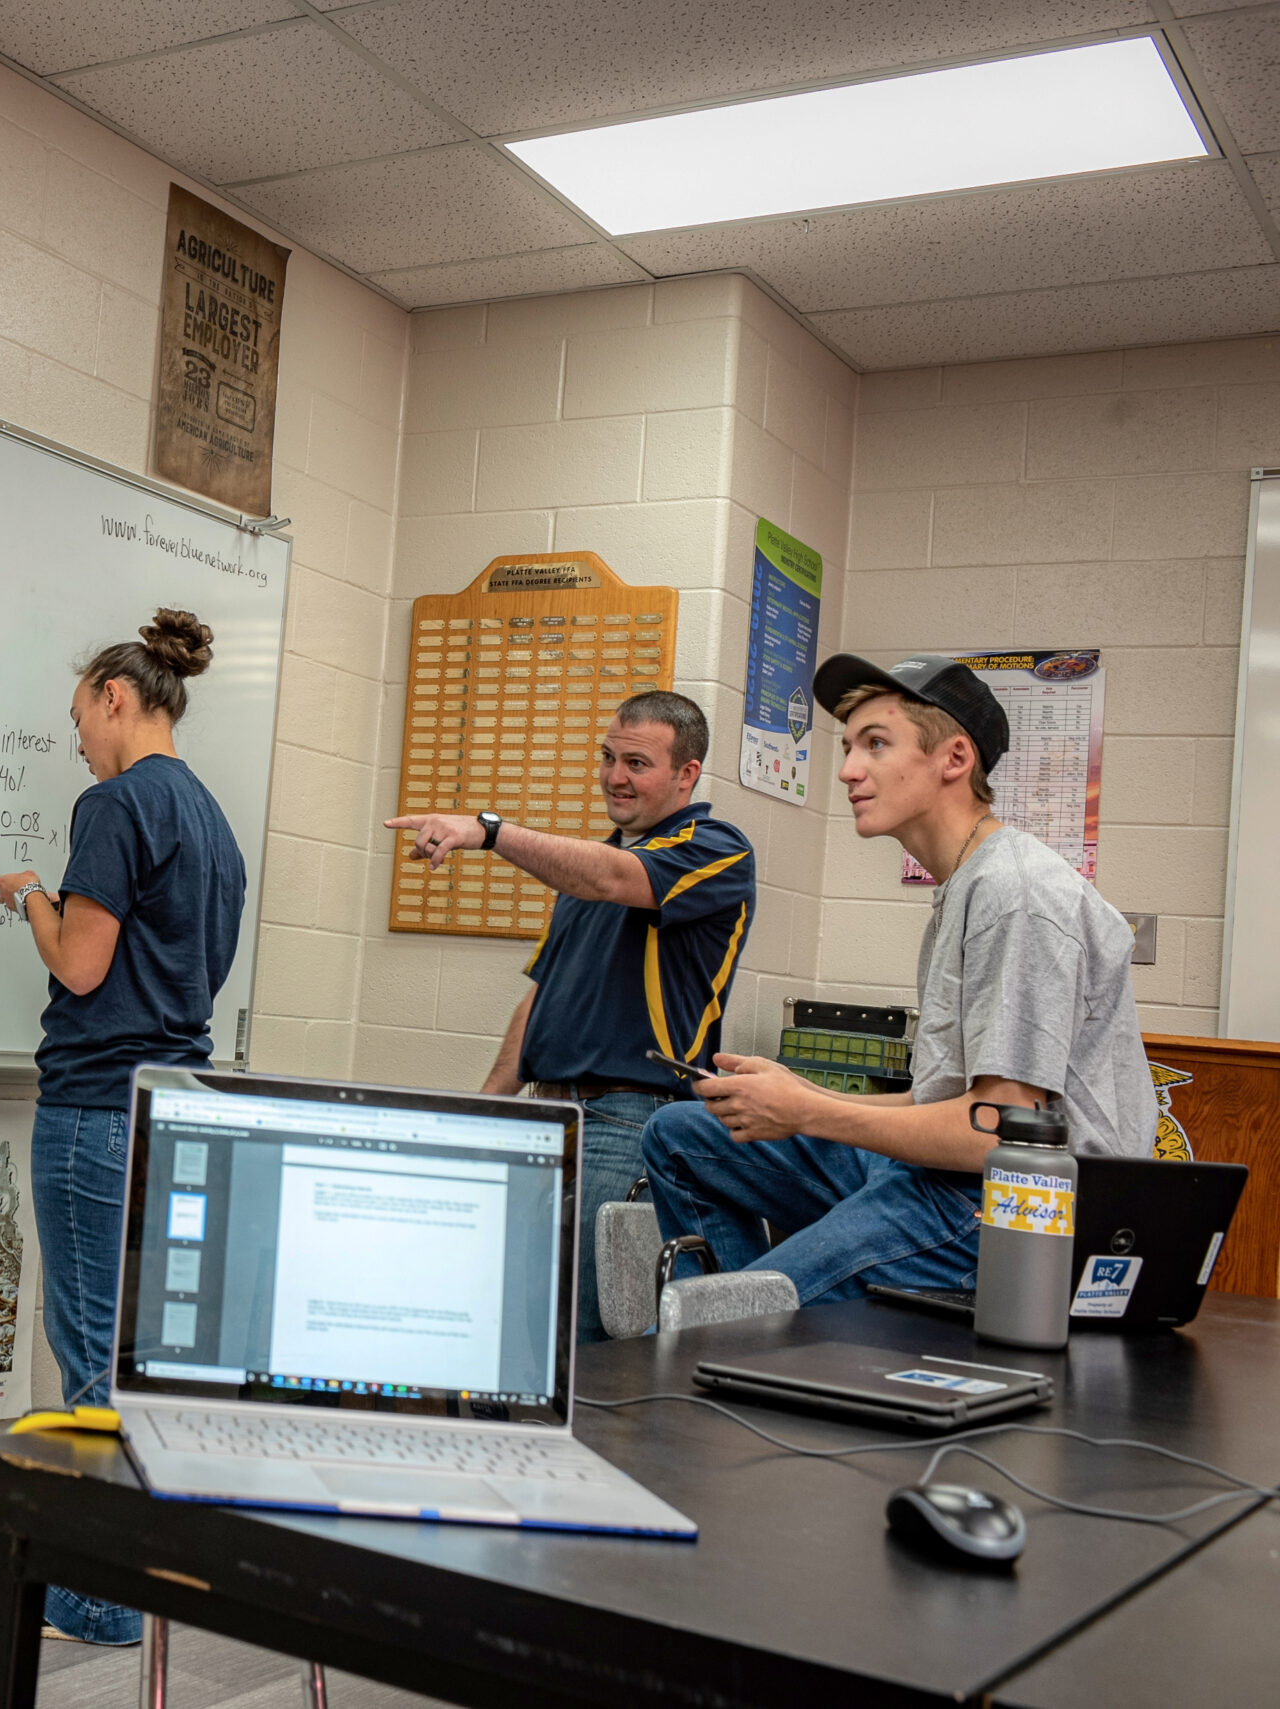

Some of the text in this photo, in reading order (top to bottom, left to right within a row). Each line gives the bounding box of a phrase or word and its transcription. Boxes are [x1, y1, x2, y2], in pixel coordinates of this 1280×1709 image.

[176, 229, 275, 304] AGRICULTURE
[185, 282, 262, 347] LARGEST
[183, 311, 260, 375] EMPLOYER
[184, 360, 211, 389] 23
[176, 418, 208, 442] AMERICAN
[209, 433, 254, 462] AGRICULTURE
[506, 568, 531, 576] PLATTE
[553, 575, 592, 584] RECIPIENTS
[988, 663, 998, 671] OF
[999, 662, 1035, 670] MOTIONS
[989, 656, 1035, 664] PROCEDURE:
[1, 725, 57, 755] interest
[13, 841, 33, 862] 12
[992, 1169, 1071, 1191] Platte Valley
[992, 1196, 1064, 1220] Advisor
[1079, 1289, 1129, 1298] PLATTE VALLEY
